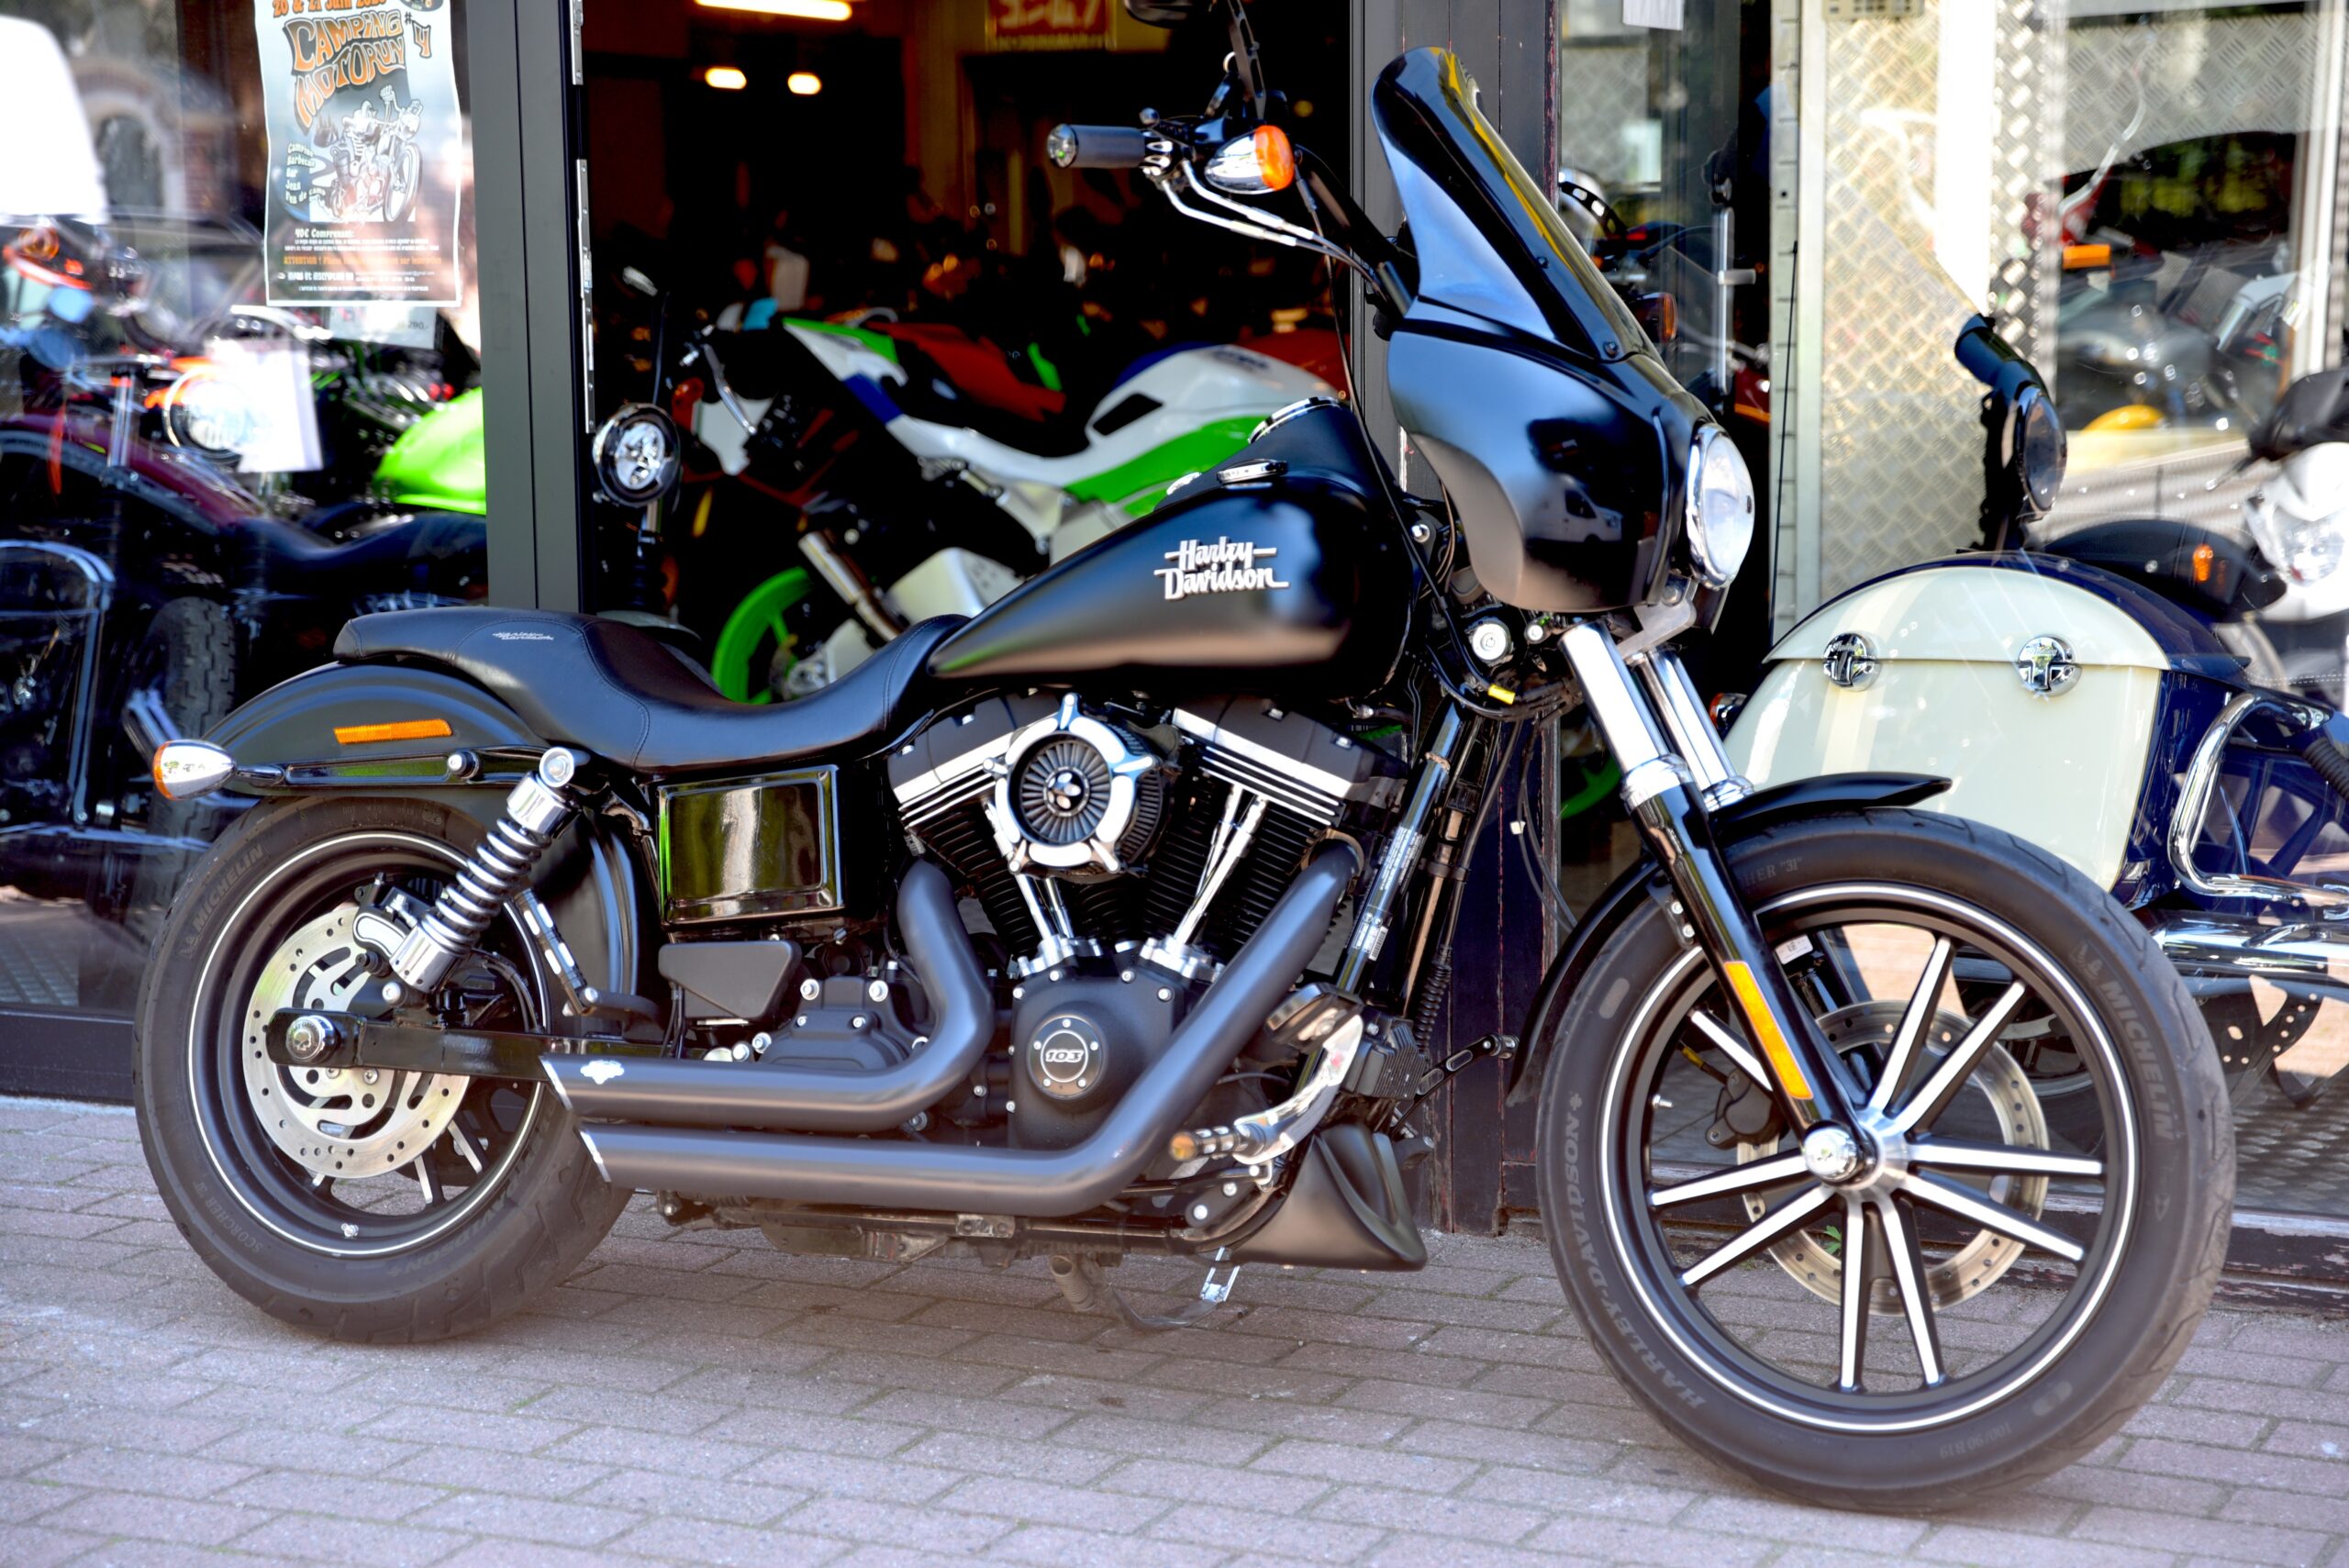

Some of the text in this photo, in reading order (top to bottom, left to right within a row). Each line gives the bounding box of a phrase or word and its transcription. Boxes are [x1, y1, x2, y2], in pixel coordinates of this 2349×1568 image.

[294, 37, 406, 132] MOTORUN
[1153, 561, 1289, 600] Davidson
[1164, 536, 1277, 572] Harley
[193, 843, 264, 932] MICHELIN
[1046, 1049, 1085, 1062] 103
[2100, 981, 2176, 1142] MICHELIN
